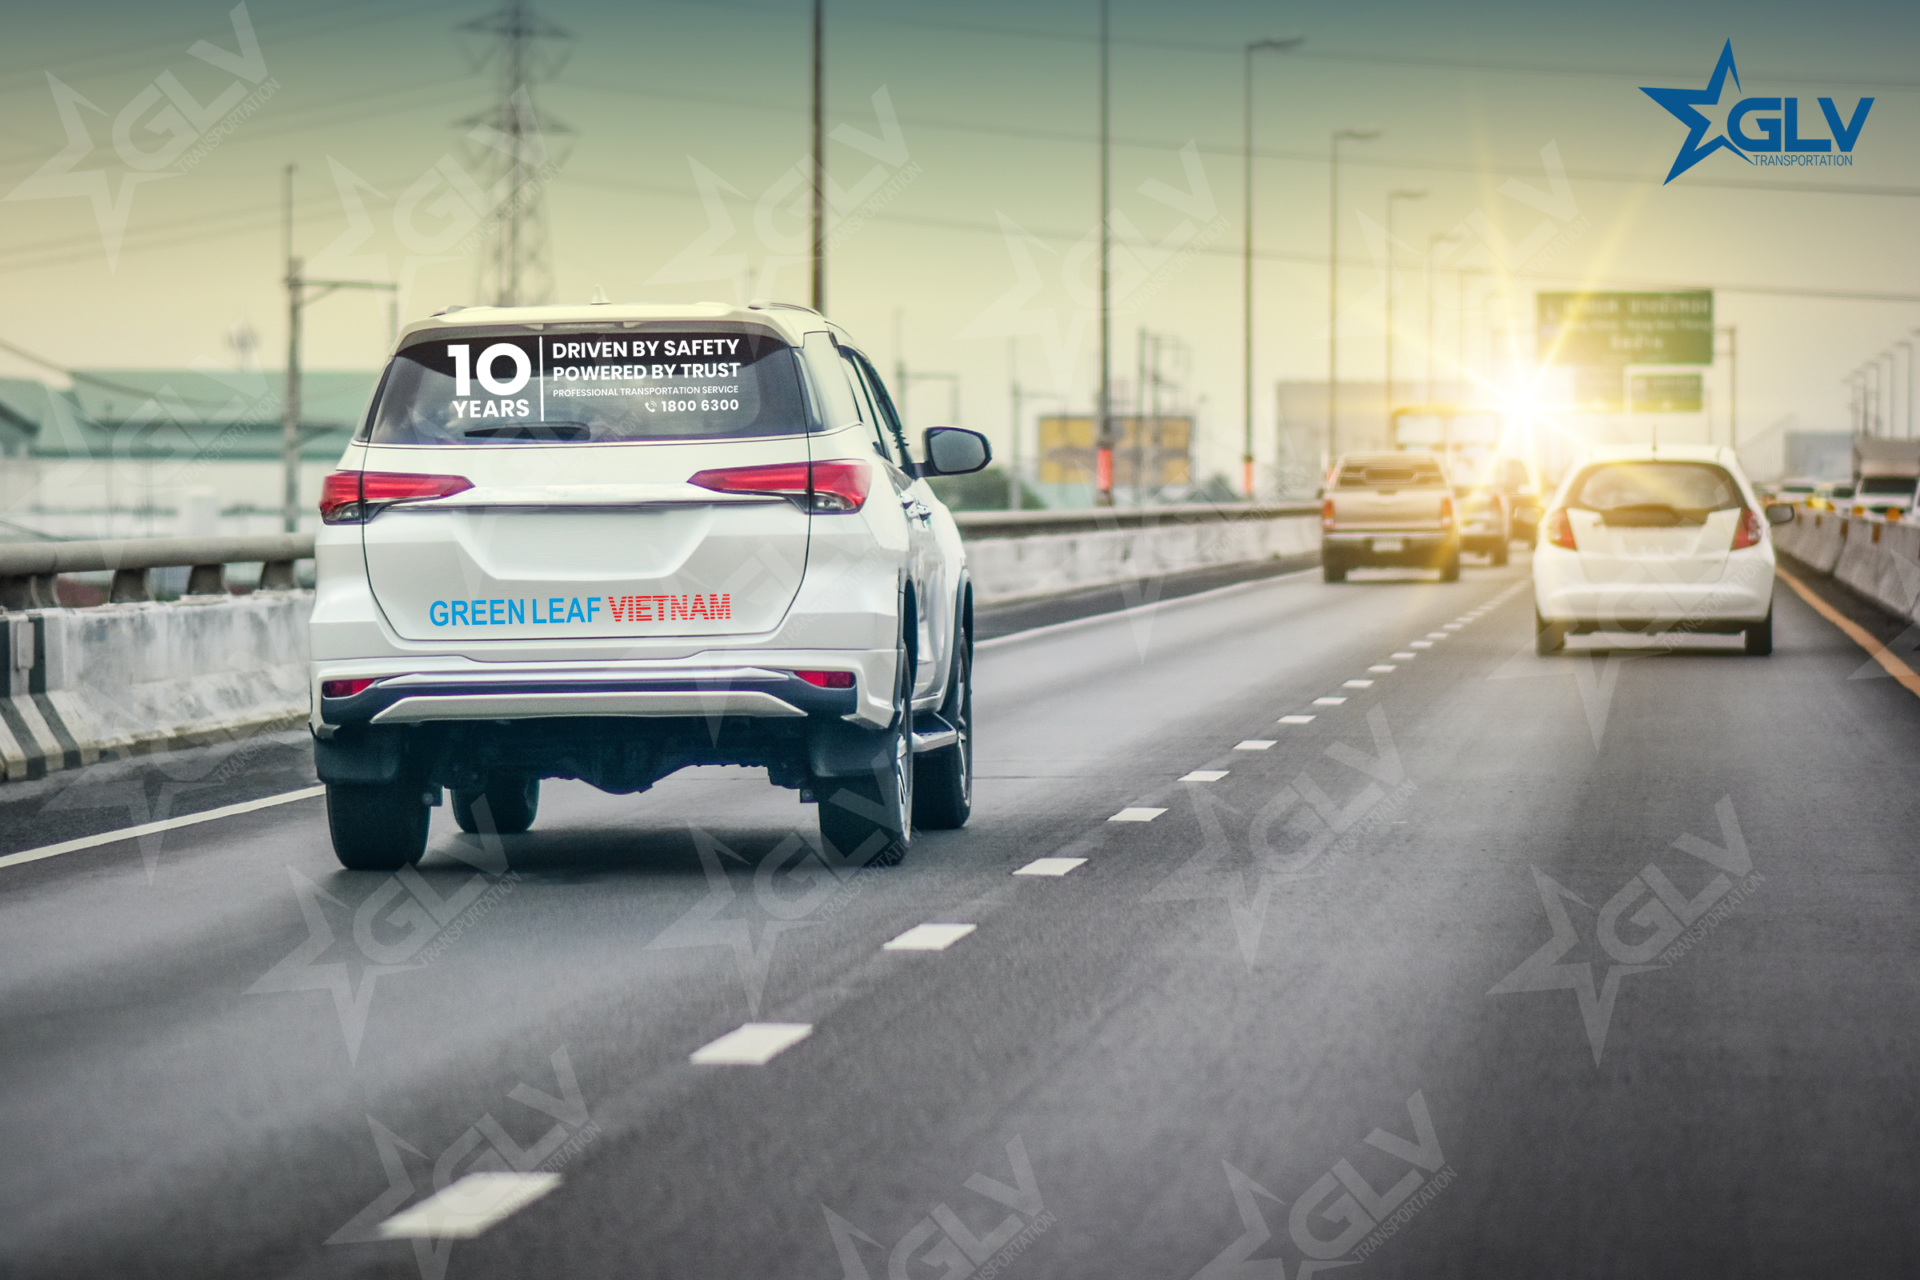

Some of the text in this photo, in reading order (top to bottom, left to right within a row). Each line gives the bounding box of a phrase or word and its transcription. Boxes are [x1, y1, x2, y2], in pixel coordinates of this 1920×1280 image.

[552, 338, 740, 359] DRIVEN BY SAFETY
[447, 342, 532, 396] 10
[553, 362, 741, 381] POWERED BY TRUST
[552, 385, 739, 398] PROFESSIONAL TRANSPORTATION SERVICE
[452, 399, 530, 418] YEARS
[661, 399, 739, 412] 1800 6300
[429, 593, 731, 627] GREEN LEAF VIETNAM
